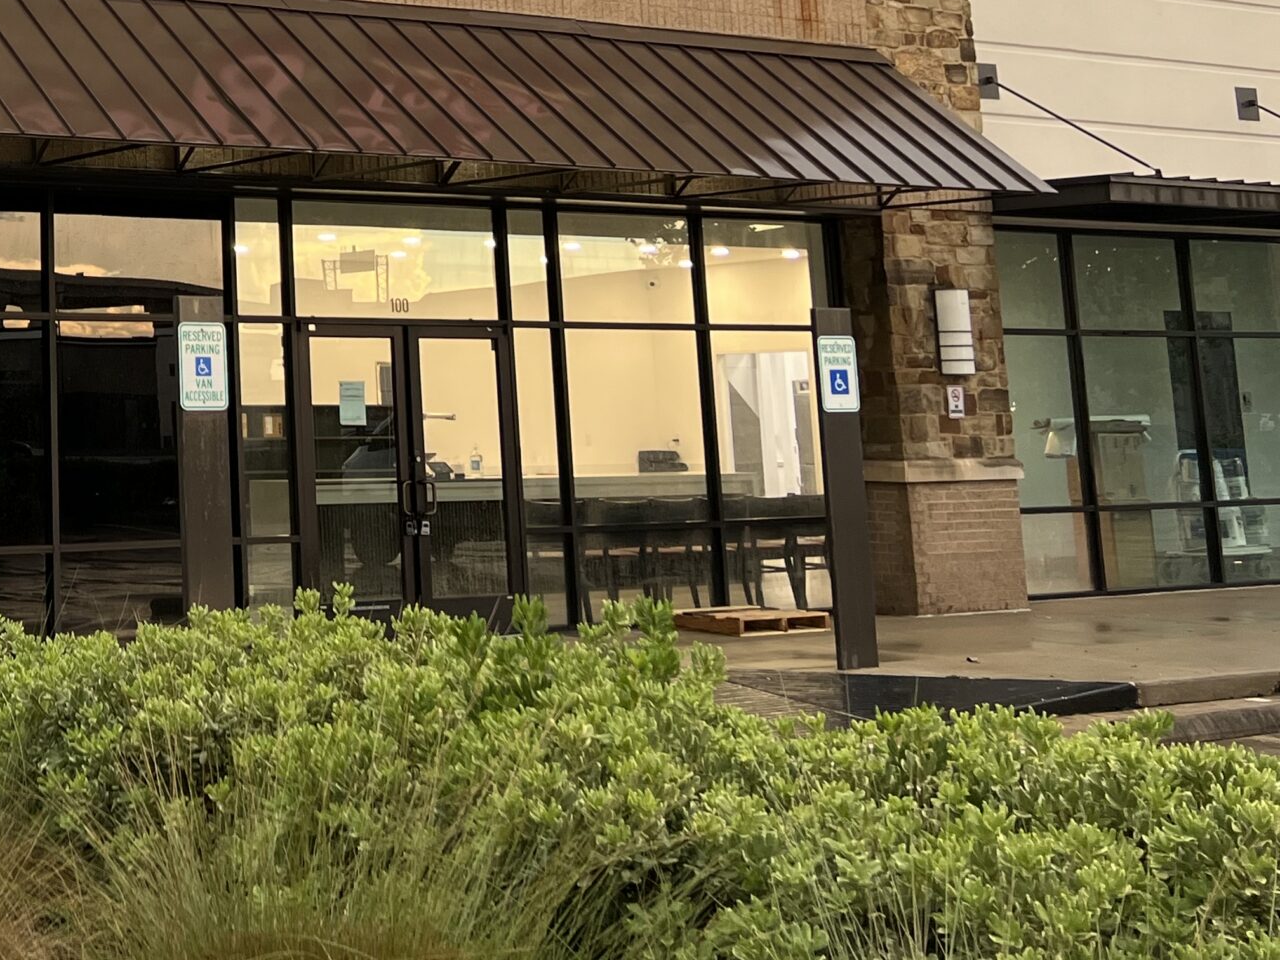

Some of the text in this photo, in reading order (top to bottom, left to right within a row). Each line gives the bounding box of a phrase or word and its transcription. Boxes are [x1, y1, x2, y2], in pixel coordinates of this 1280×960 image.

[390, 298, 409, 313] 100
[183, 331, 221, 341] RESERVED
[185, 344, 220, 354] PARKING
[821, 344, 853, 353] RESERVED
[824, 356, 851, 366] PARKING
[195, 379, 213, 389] VAN
[185, 391, 224, 401] ACCESSIBLE
